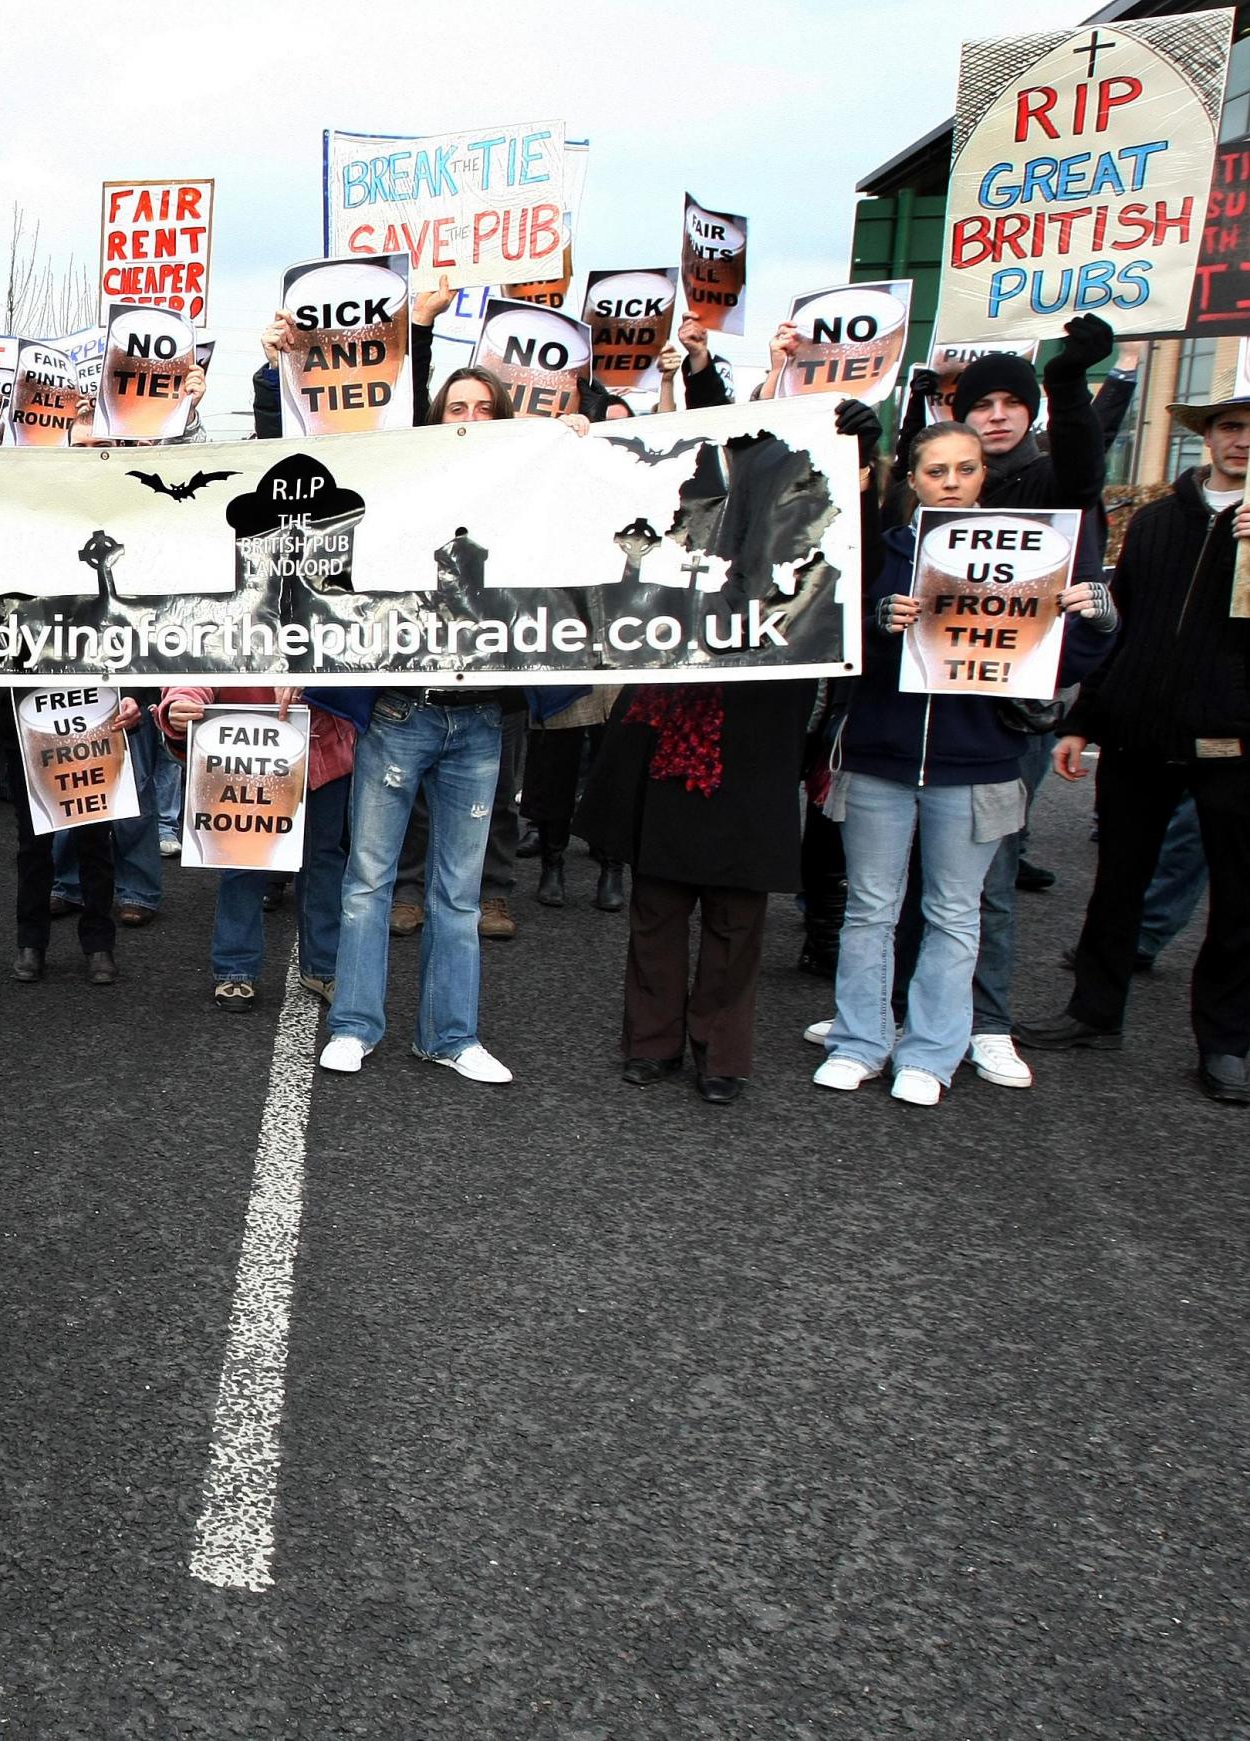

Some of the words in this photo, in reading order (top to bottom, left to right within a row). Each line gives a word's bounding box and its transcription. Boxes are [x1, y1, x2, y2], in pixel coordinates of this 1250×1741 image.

[1014, 75, 1143, 143] RIP
[342, 144, 459, 209] BREAK
[452, 157, 480, 173] THE
[467, 130, 551, 191] TIE
[978, 140, 1169, 211] GREAT
[109, 187, 202, 223] FAIR
[348, 217, 456, 270] SAVE
[446, 225, 471, 241] THE
[473, 204, 561, 264] PUB
[692, 213, 726, 241] FAIR
[950, 196, 1194, 270] BRITISH
[107, 226, 206, 261] RENT
[103, 262, 205, 295] CHEAPER
[987, 260, 1154, 318] PUBS
[296, 297, 393, 331] SICK
[595, 297, 667, 318] SICK
[594, 327, 656, 345] AND
[812, 315, 878, 344] NO
[126, 333, 177, 359] NO
[303, 340, 387, 373] AND
[502, 336, 569, 371] NO
[34, 352, 68, 371] FAIR
[592, 354, 651, 371] TIED
[797, 356, 884, 385] TIE!
[25, 370, 75, 390] PINTS
[80, 381, 97, 394] US
[113, 370, 183, 399] TIE!
[31, 392, 65, 409] ALL
[301, 381, 392, 413] TIED
[272, 476, 325, 500] R.I.P
[278, 513, 312, 530] THE
[241, 536, 308, 554] BRITISH
[313, 535, 350, 552] PUB
[948, 529, 1043, 551] FREE
[246, 558, 343, 577] LANDLORD
[966, 563, 1014, 583] US
[934, 595, 1039, 618] FROM
[945, 627, 1018, 650] THE
[943, 660, 1013, 682] TIE!
[34, 687, 99, 713] FREE
[53, 715, 87, 736] US
[218, 727, 280, 746] FAIR
[41, 739, 111, 767] FROM
[206, 755, 289, 777] PINTS
[54, 767, 106, 792] THE
[59, 793, 107, 817] TIE!
[219, 785, 272, 805] ALL
[194, 812, 293, 834] ROUND
